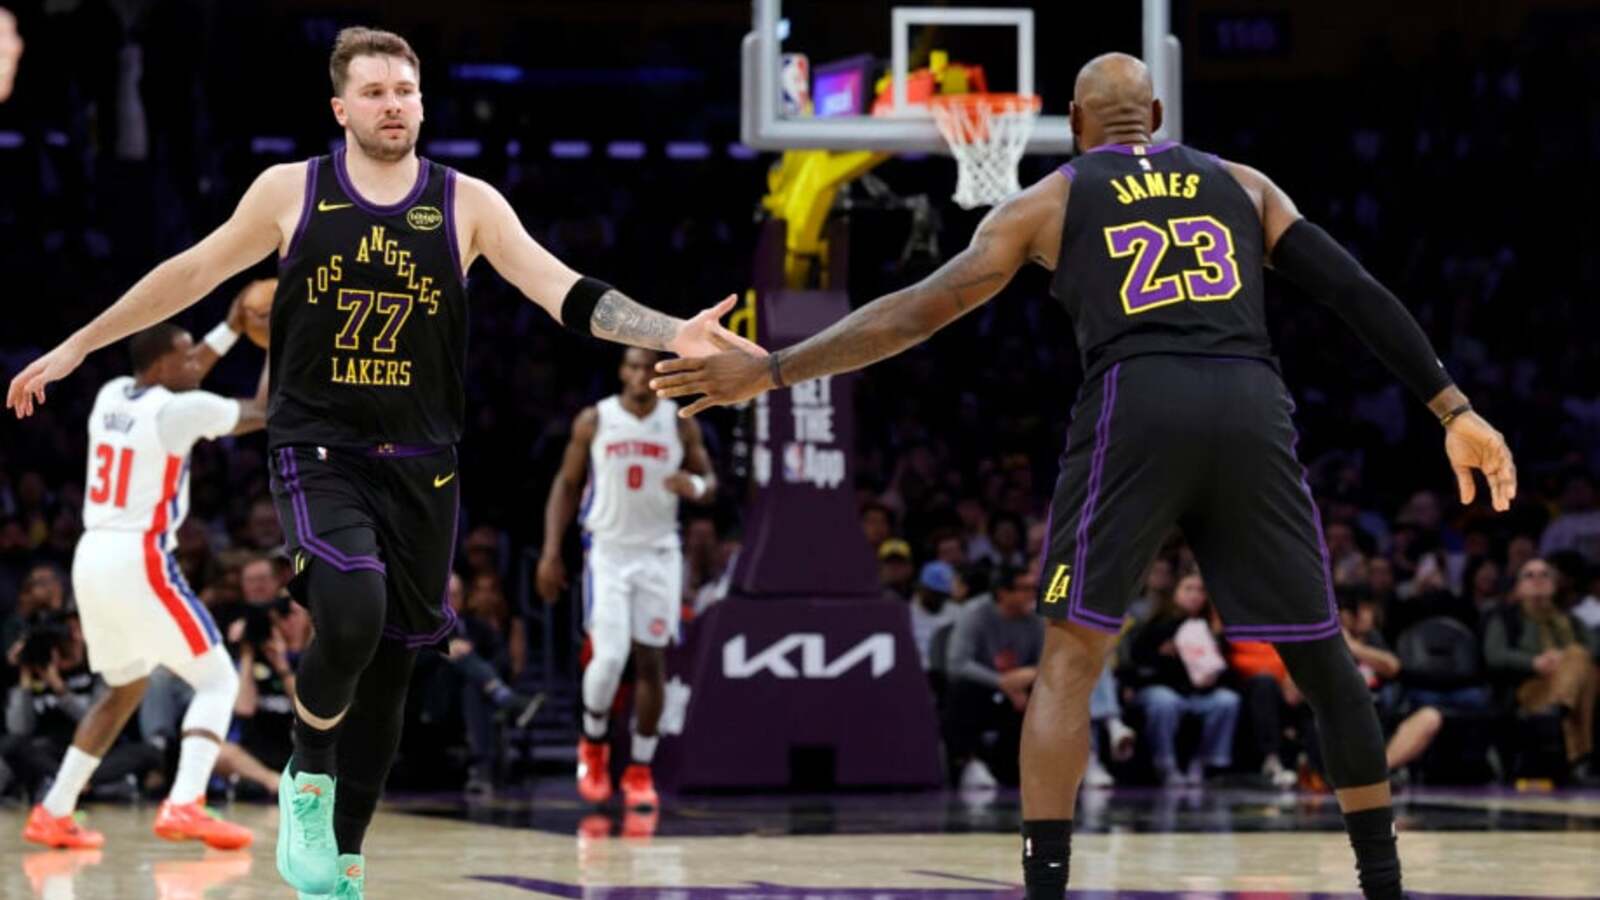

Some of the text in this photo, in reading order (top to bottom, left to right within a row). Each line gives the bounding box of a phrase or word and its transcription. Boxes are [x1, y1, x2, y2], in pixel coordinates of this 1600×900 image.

[1110, 172, 1199, 204] JAMES
[307, 226, 441, 315] LOS ANGELES
[1104, 215, 1242, 315] 23
[335, 288, 413, 352] 77
[331, 357, 412, 386] LAKERS
[791, 406, 835, 442] THE
[90, 443, 134, 508] 31
[627, 464, 643, 490] 0
[1044, 565, 1070, 603] LA
[723, 633, 895, 678] KIA
